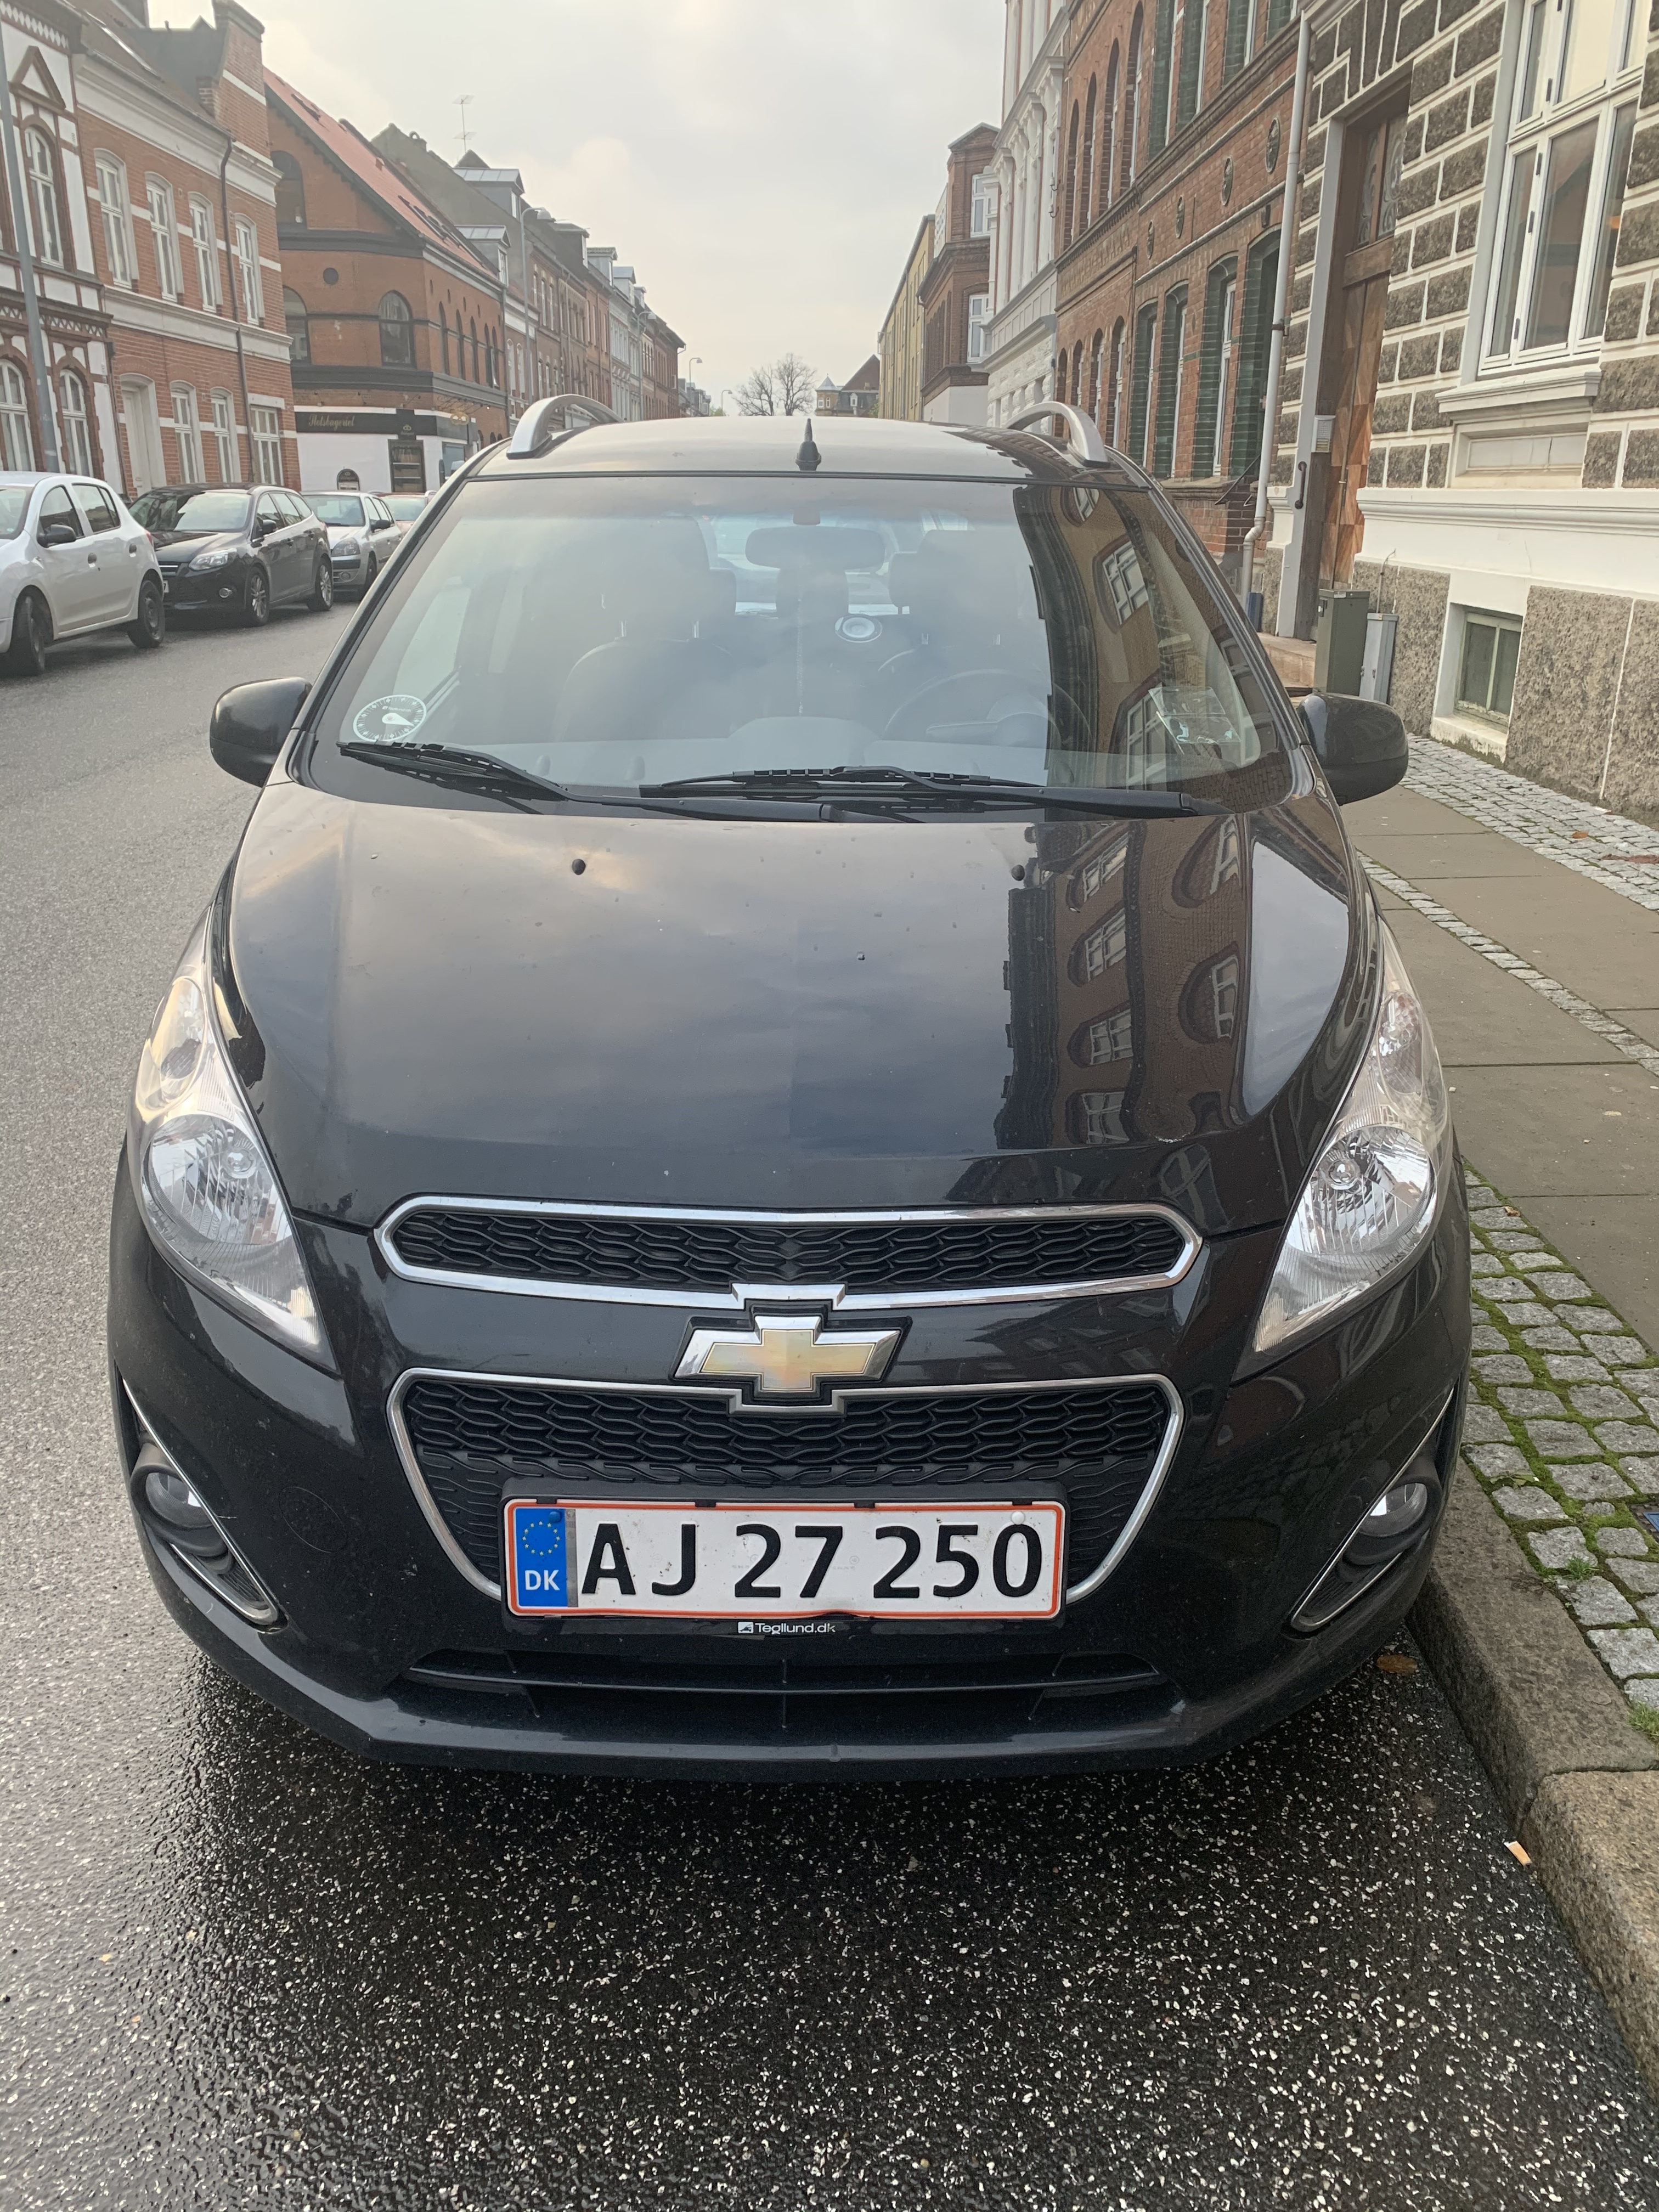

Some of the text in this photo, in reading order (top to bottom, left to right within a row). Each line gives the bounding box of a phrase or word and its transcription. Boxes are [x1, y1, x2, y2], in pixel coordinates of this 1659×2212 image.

[581, 1523, 1042, 1598] AJ 27 250
[524, 1570, 560, 1591] DK
[754, 1623, 836, 1635] Tegllund.dk
